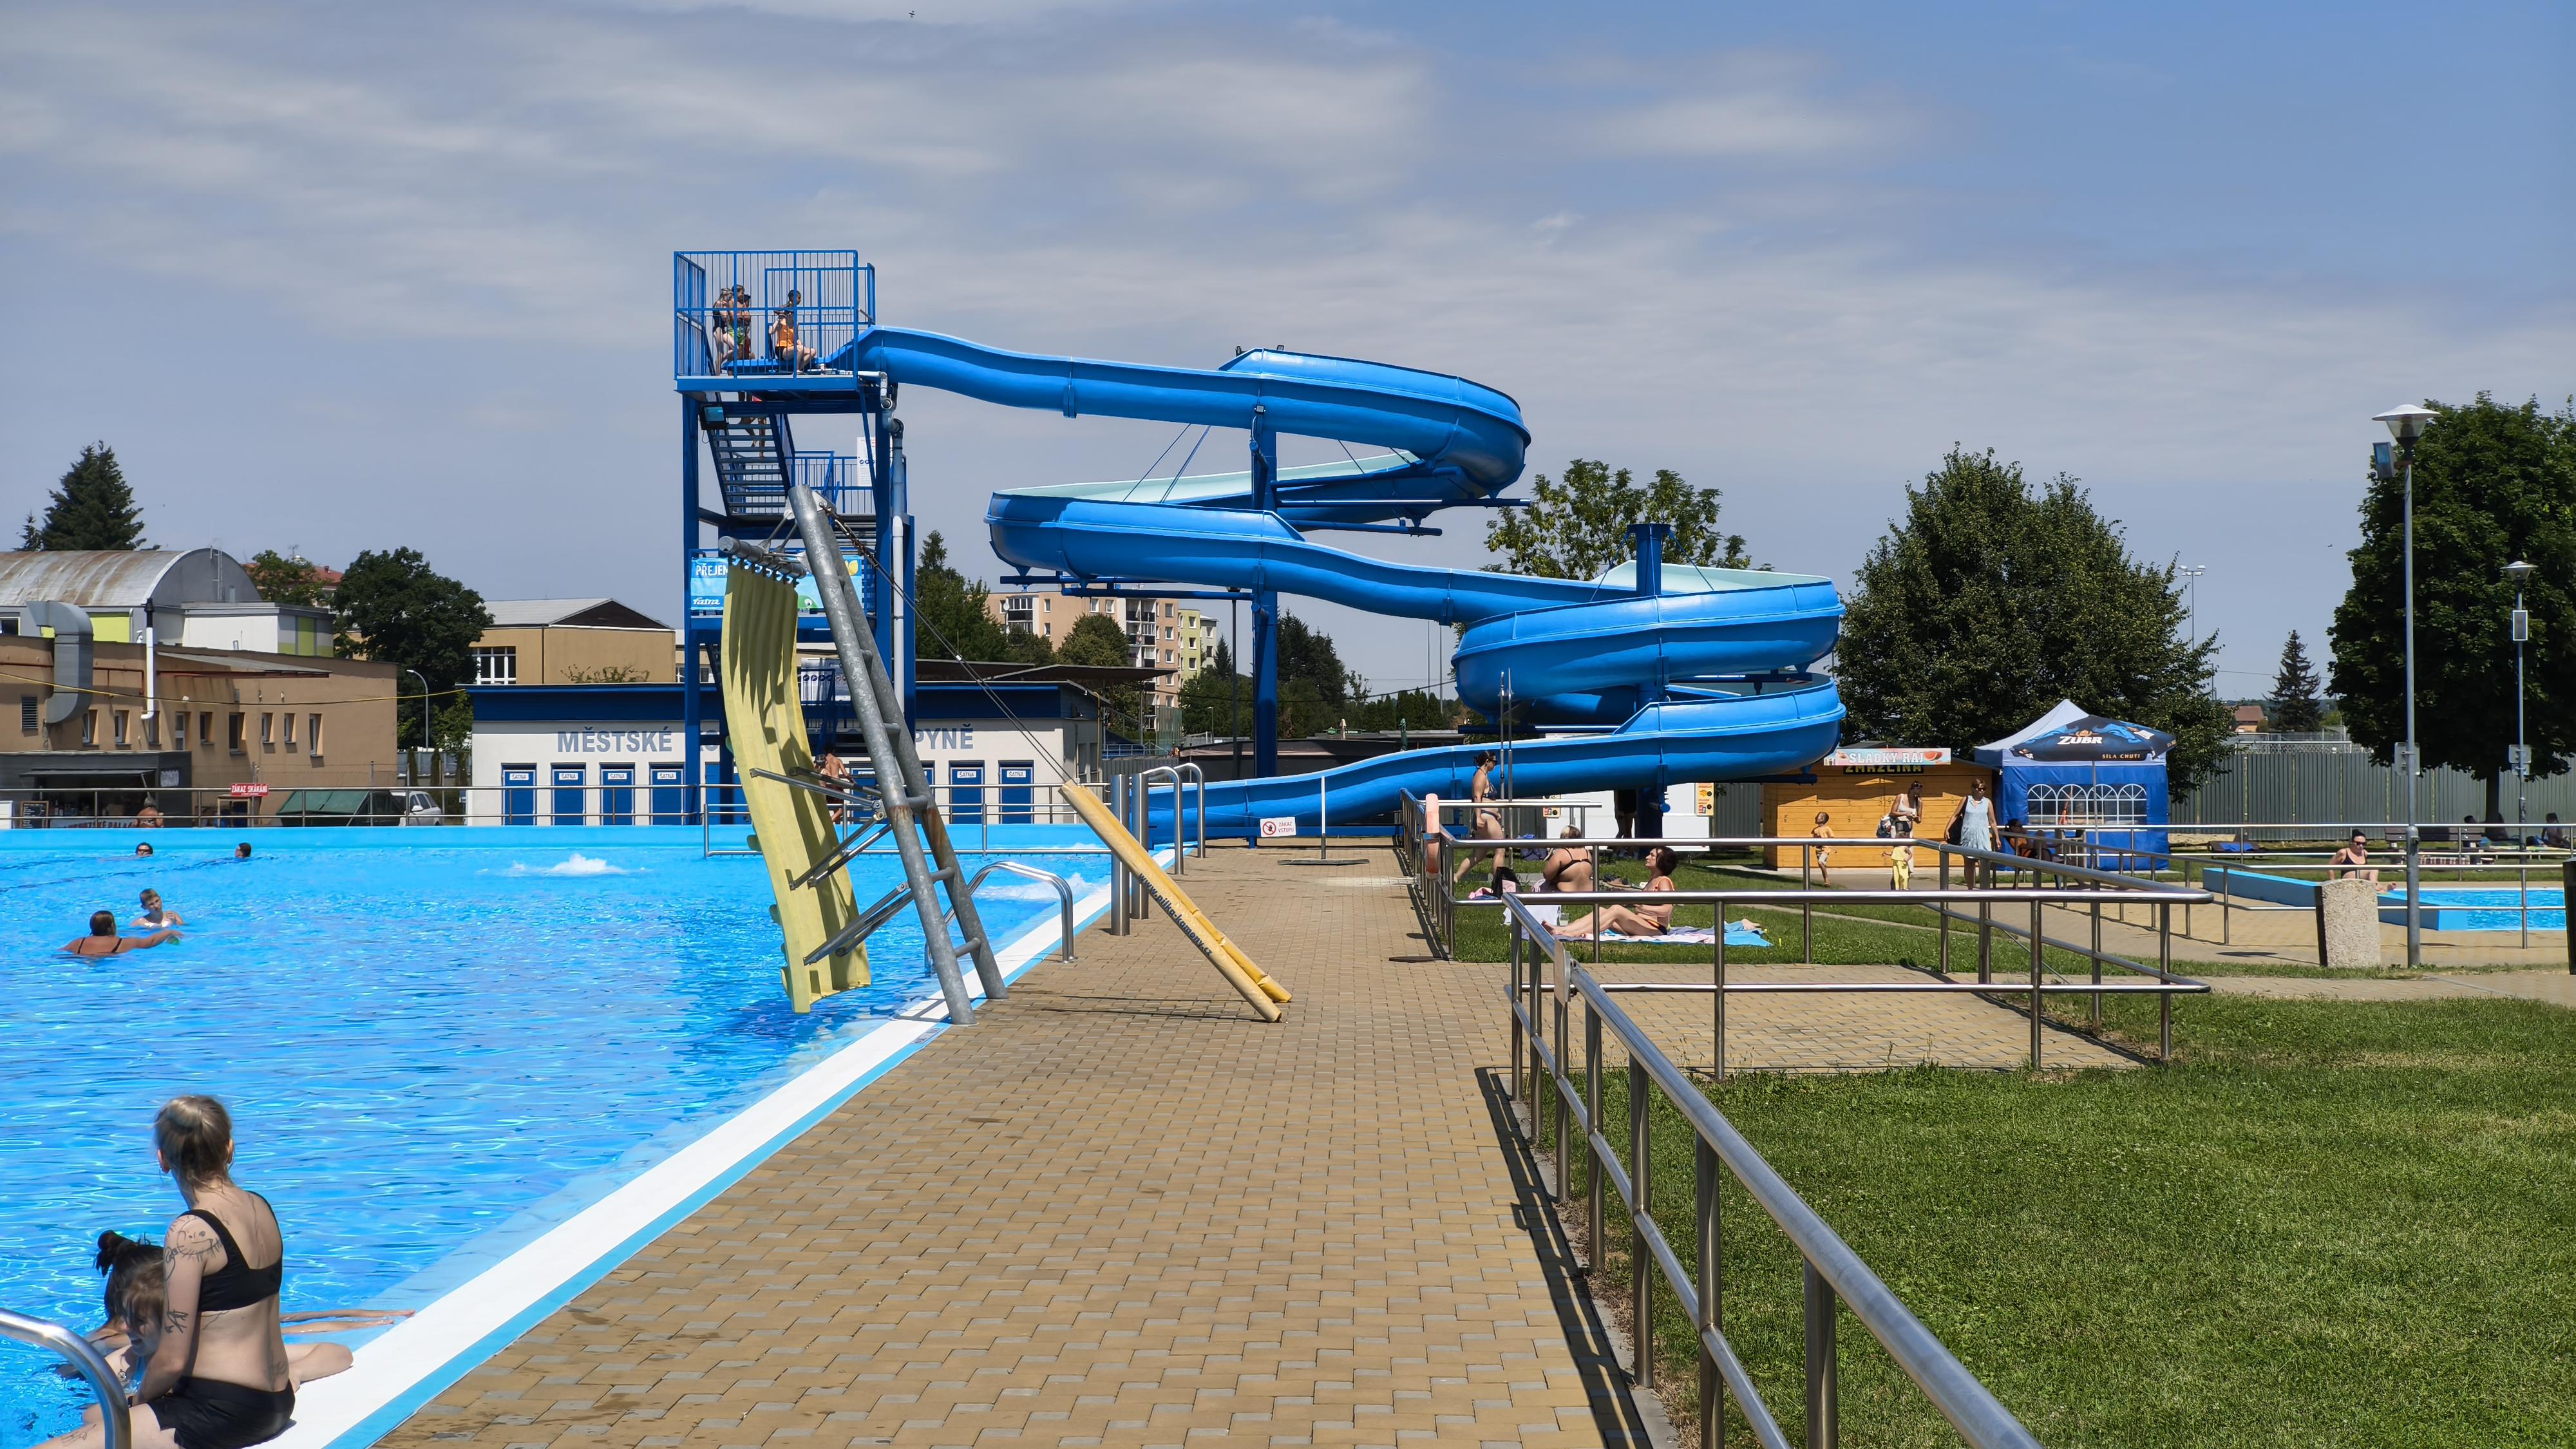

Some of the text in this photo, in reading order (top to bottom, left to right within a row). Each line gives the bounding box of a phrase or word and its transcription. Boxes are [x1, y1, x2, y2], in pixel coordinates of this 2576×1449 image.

[557, 726, 672, 753] MĚSTSKÉ
[2057, 735, 2103, 745] ZUBR
[1849, 750, 1924, 763] SLADKÝ RÁJ
